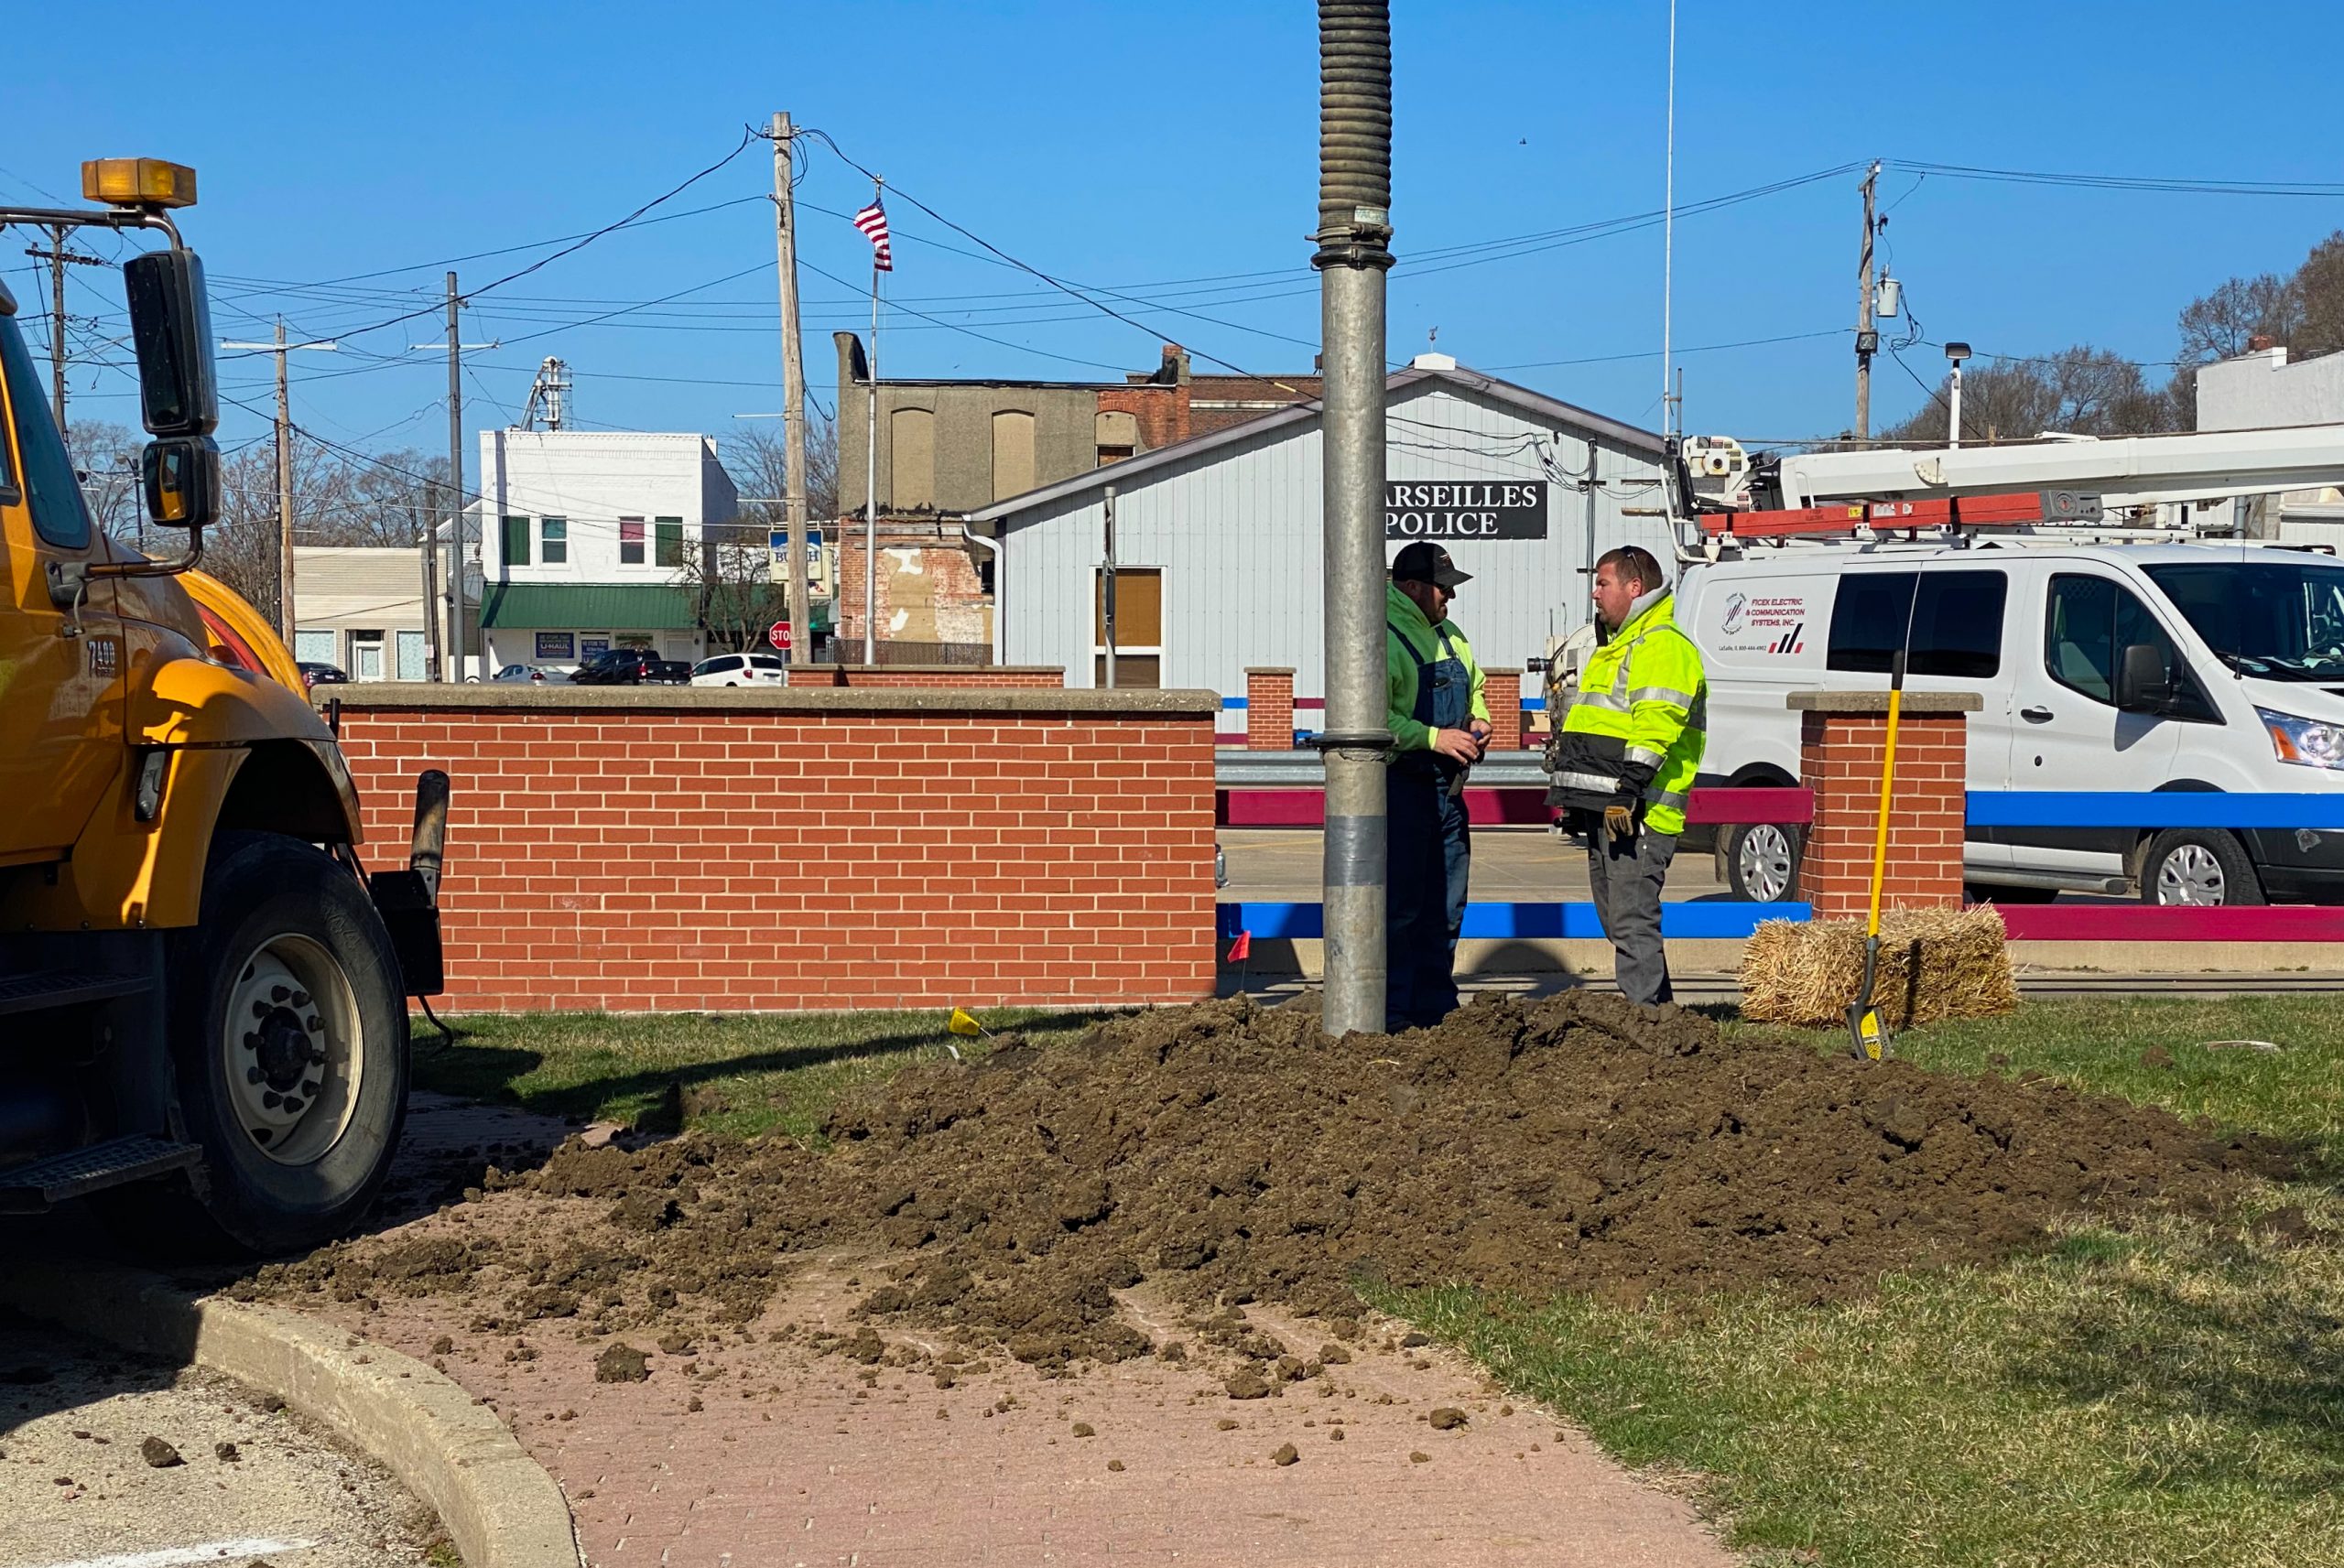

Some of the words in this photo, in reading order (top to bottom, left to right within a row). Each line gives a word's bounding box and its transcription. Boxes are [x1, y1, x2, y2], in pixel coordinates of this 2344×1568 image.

[1386, 485, 1537, 507] RSEILLES
[1386, 512, 1499, 535] POLICE
[771, 630, 789, 641] STO
